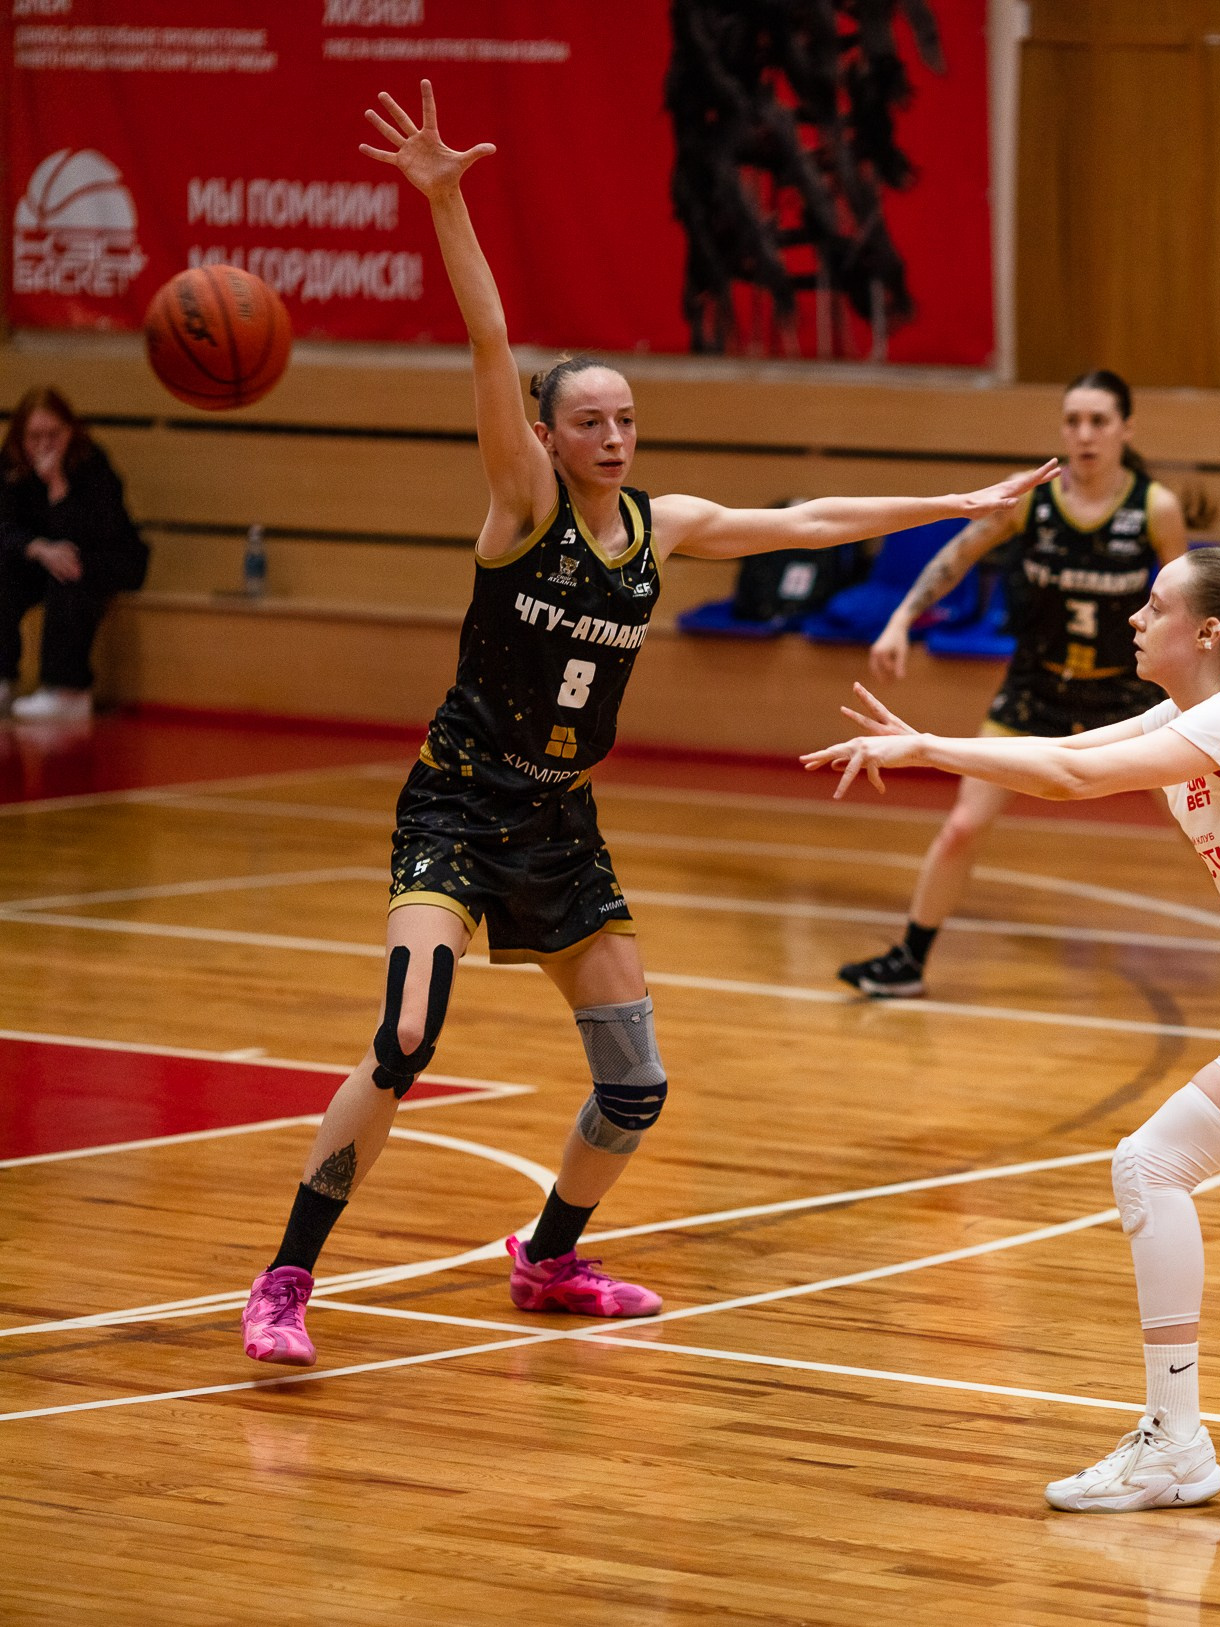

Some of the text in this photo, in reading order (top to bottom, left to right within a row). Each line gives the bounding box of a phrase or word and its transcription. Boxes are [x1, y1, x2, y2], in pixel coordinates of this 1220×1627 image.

[187, 178, 245, 228] МЫ
[557, 658, 597, 709] 8
[1187, 790, 1211, 812] BET
